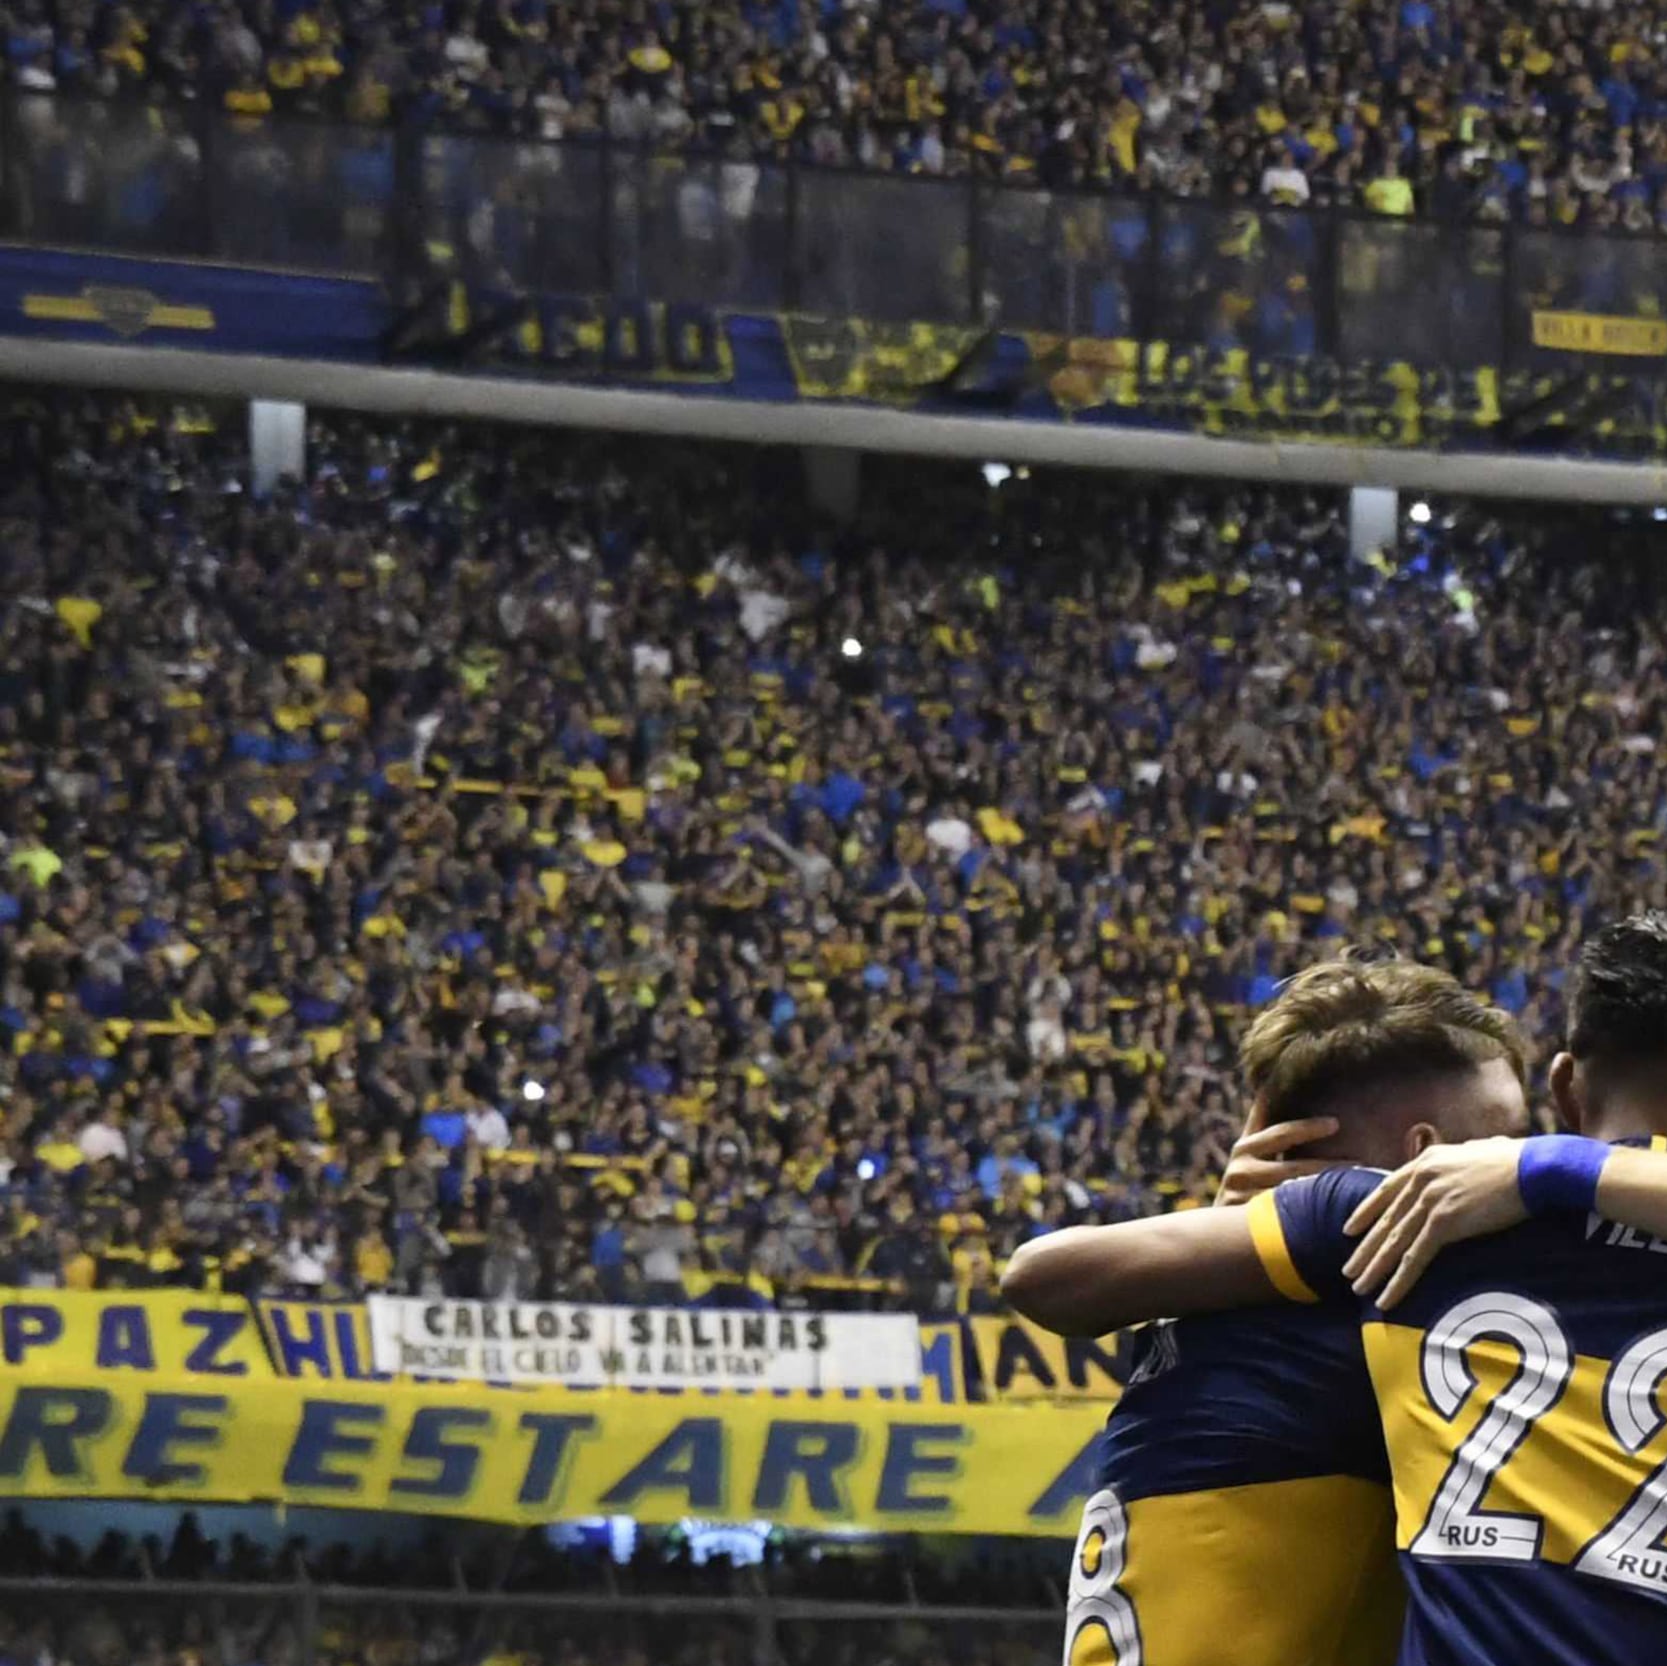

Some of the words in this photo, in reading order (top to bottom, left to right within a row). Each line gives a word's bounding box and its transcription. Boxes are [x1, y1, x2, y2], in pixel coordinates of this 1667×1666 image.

[0, 1305, 248, 1375] PAZ
[424, 1305, 592, 1342] CARLOS
[629, 1311, 827, 1351] SALINAS
[282, 1400, 966, 1513] ESTARE
[1446, 1525, 1499, 1549] RUS
